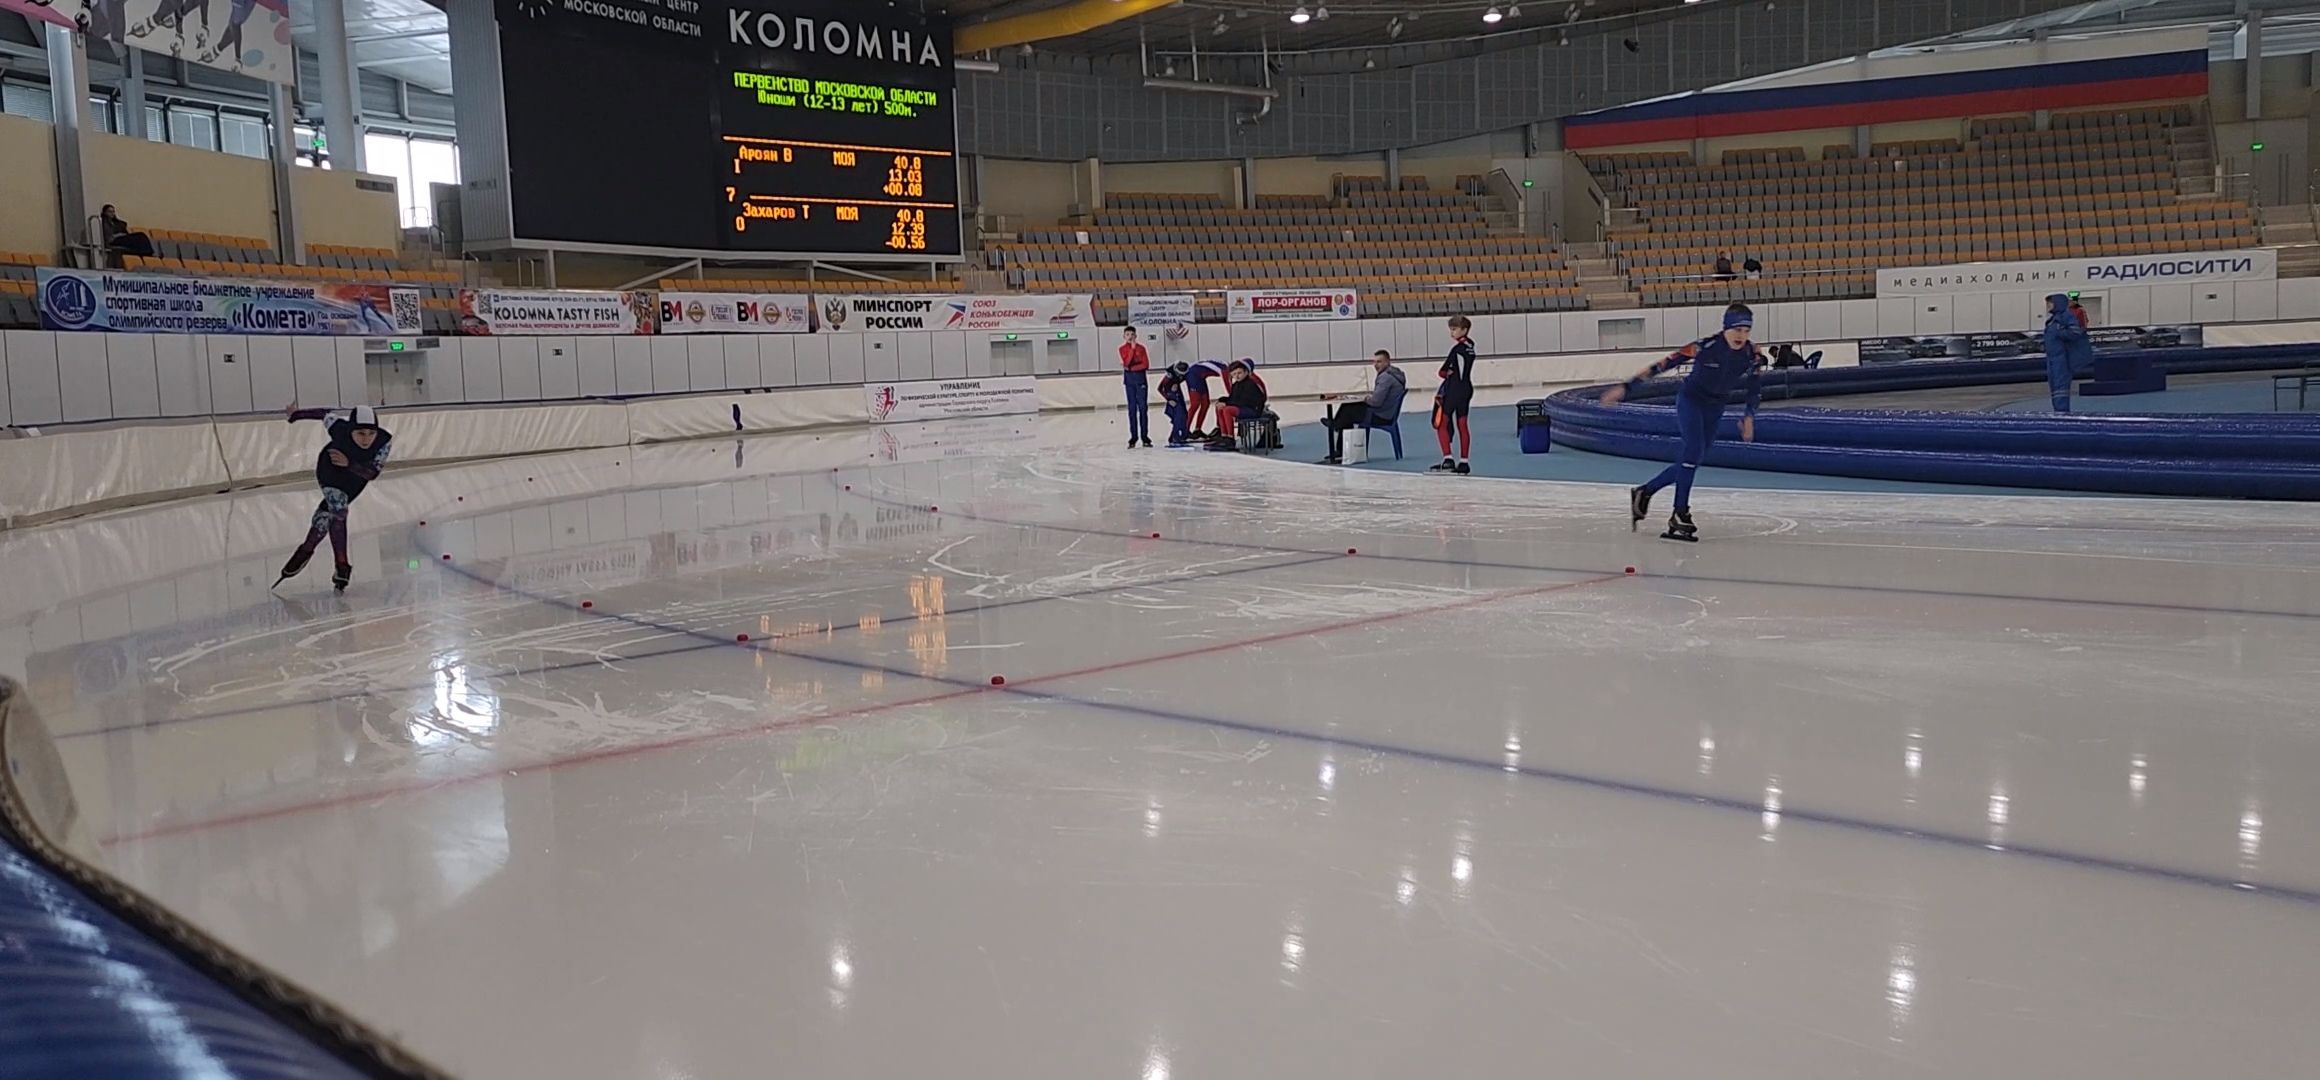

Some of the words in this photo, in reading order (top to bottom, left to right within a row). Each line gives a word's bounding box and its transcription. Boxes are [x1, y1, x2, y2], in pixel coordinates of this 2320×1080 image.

[564, 0, 647, 25] МОСКОВСКОЙ
[653, 16, 701, 37] ОБЛАСТИ
[729, 9, 942, 67] КОЛОМНА
[734, 72, 809, 93] ПЕРВЕНСТВО
[815, 80, 885, 101] МОСКОВСКОЙ
[890, 89, 936, 106] ОБЛАСТИ
[758, 90, 795, 106] Юноши
[804, 94, 845, 111] (12-13
[851, 100, 878, 114] лет)
[885, 102, 917, 117] 500м.
[739, 145, 778, 162] Ароян
[833, 151, 855, 166] МОЯ
[894, 156, 921, 170] 40.8
[889, 169, 921, 183] 13.03
[726, 187, 736, 202] 7
[883, 184, 922, 197] +00.08
[742, 202, 795, 219] Захаров
[836, 206, 858, 221] МОЯ
[896, 209, 924, 223] 40.8
[892, 222, 924, 236] 12.39
[885, 236, 925, 249] -00.56
[1894, 269, 2071, 287] медиахолдинг
[2087, 258, 2252, 281] РАДИОСИТИ
[103, 275, 189, 295] Муниципальное
[193, 280, 251, 298] бюджетное
[255, 287, 315, 300] учреждение
[106, 297, 165, 312] спортивная
[170, 300, 203, 312] школа
[853, 300, 932, 312] МИНСПОРТ
[972, 300, 996, 308] СОЮЗ
[1257, 297, 1327, 308] ЛОР-ОРГАНОВ
[109, 314, 183, 329] олимпийского
[187, 317, 227, 331] резерва
[233, 303, 315, 329] «Комета»
[494, 307, 555, 321] KOLOMNA
[556, 308, 591, 320] TASTY
[593, 308, 620, 320] FISH
[970, 310, 1034, 319] КОНЬКОБЕЖЦЕВ
[865, 317, 924, 329] РОССИИ
[940, 382, 981, 391] УПРАВЛЕНИЕ
